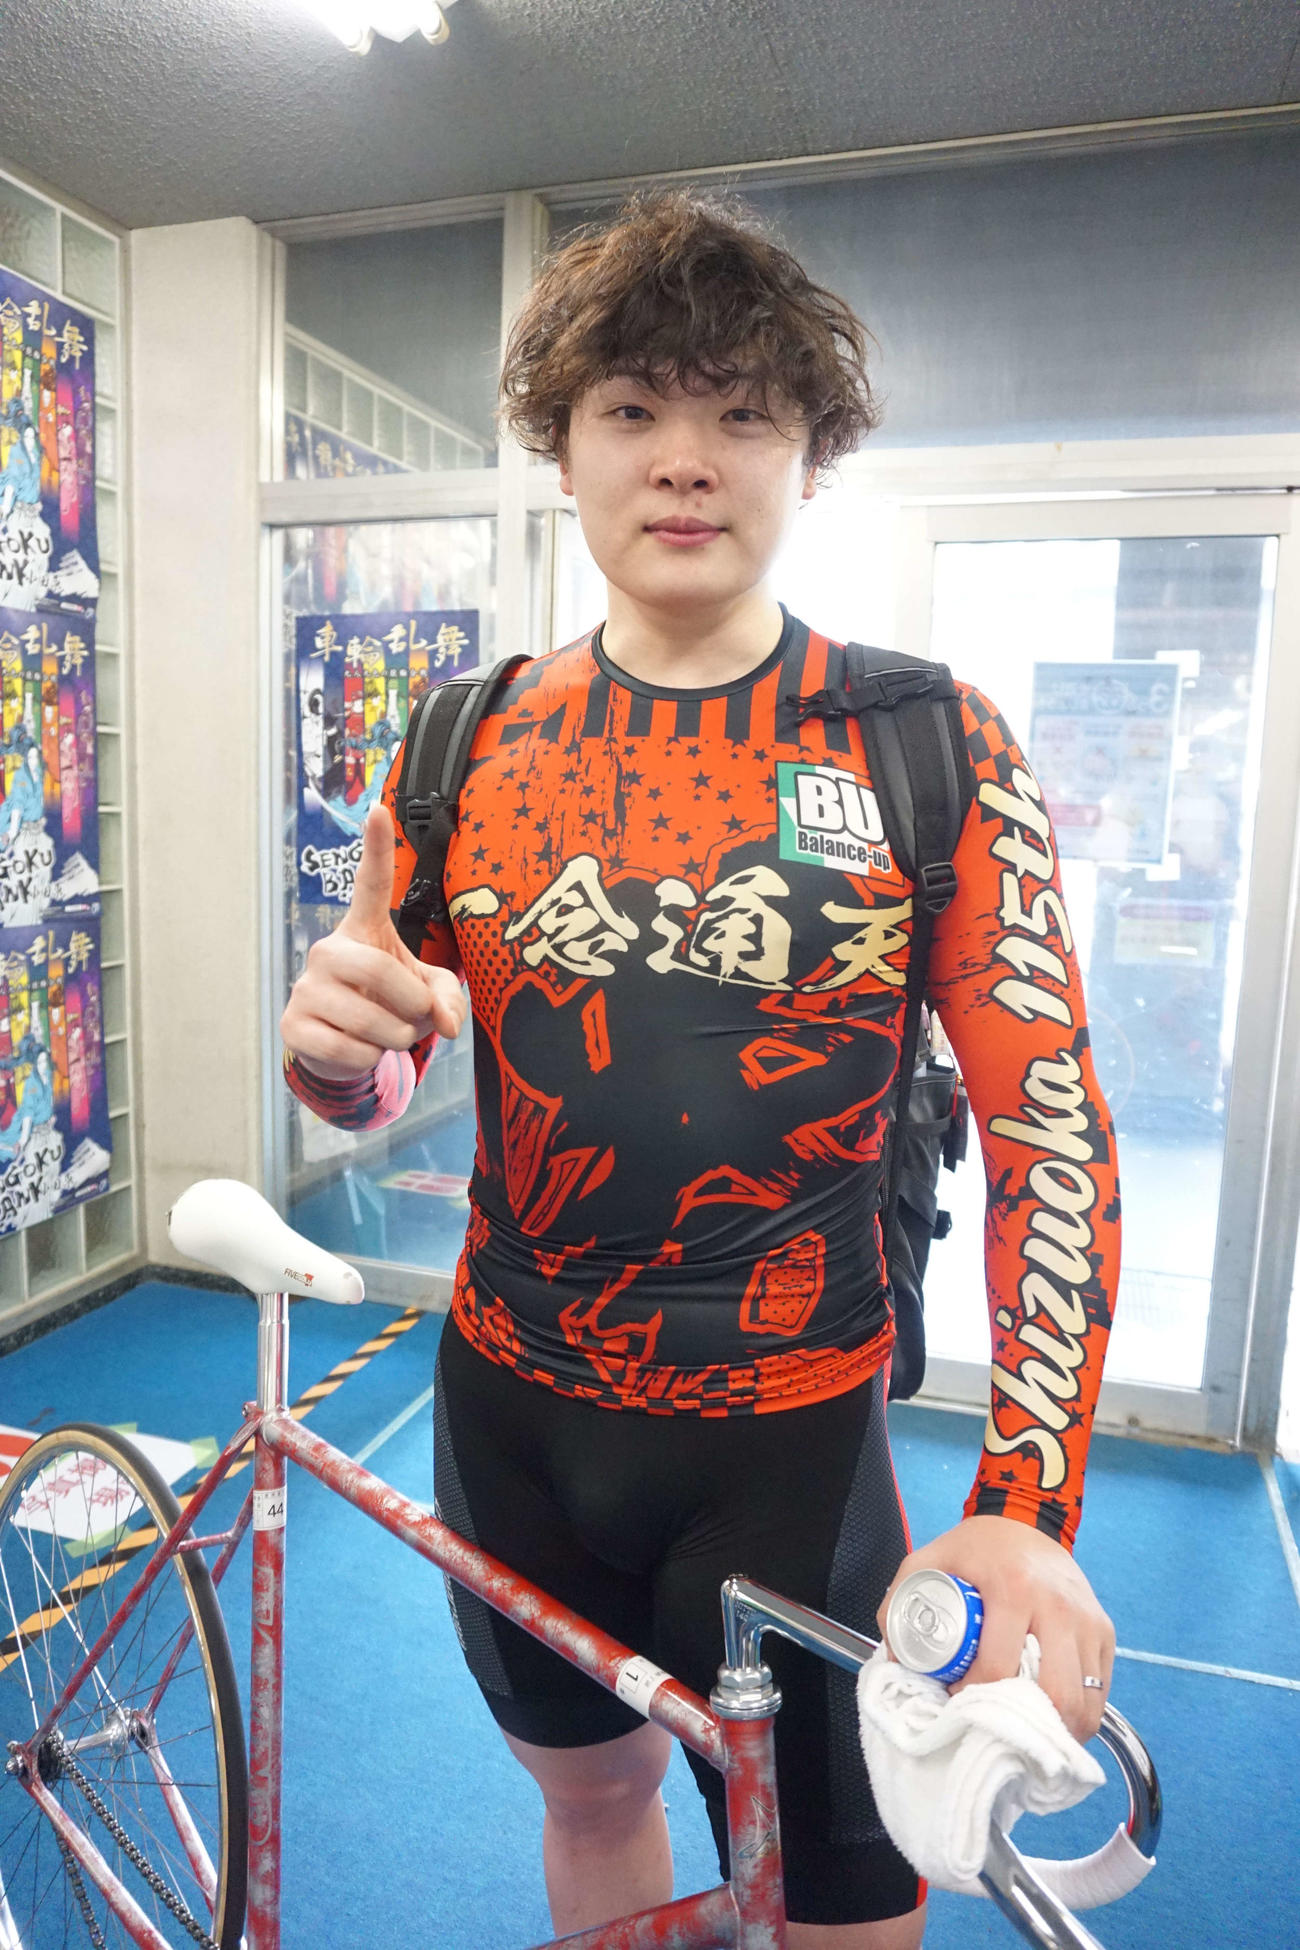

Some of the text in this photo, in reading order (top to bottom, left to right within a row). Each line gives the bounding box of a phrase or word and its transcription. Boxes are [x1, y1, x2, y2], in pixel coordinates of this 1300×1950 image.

[0, 529, 50, 555] OKU
[309, 619, 470, 669] 車輪乱舞
[794, 771, 886, 845] BU
[797, 830, 892, 872] Balance-up
[978, 760, 1073, 1027] 115th
[984, 1049, 1096, 1489] Shizuoka
[267, 1501, 284, 1518] 44
